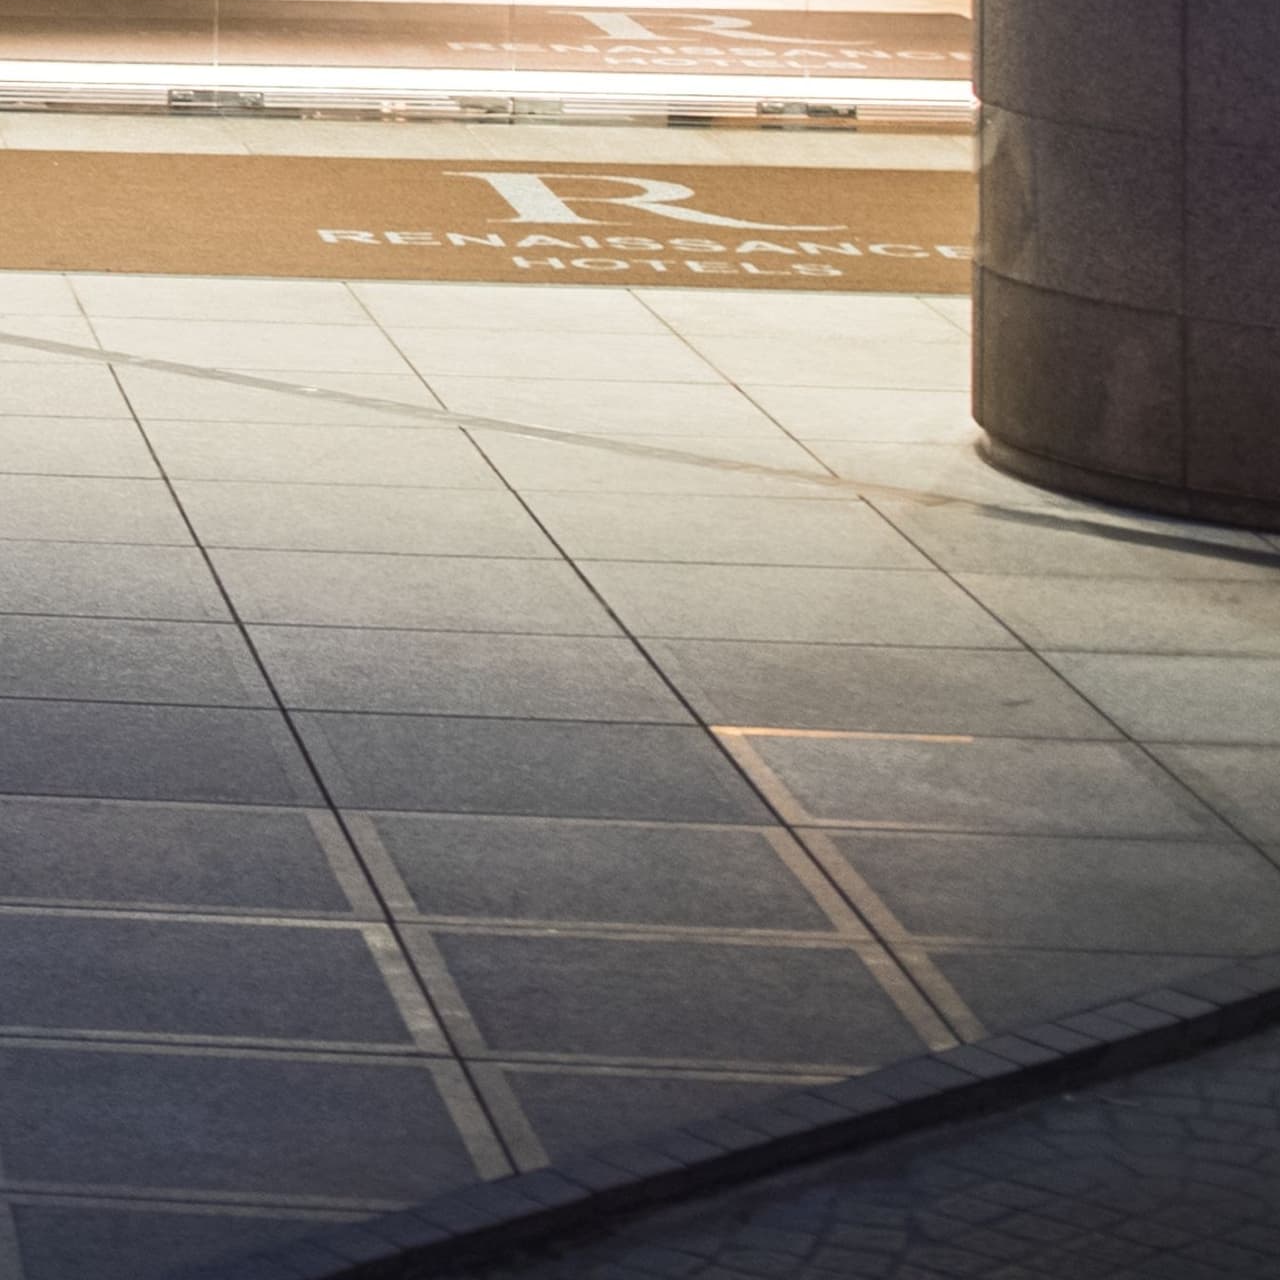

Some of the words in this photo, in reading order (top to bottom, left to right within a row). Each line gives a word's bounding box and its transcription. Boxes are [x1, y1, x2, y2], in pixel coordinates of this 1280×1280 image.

[548, 9, 874, 46] R
[604, 56, 869, 70] HOTELS
[442, 170, 848, 231] R
[316, 228, 973, 261] RENAISSANCE
[510, 254, 844, 278] HOTELS
